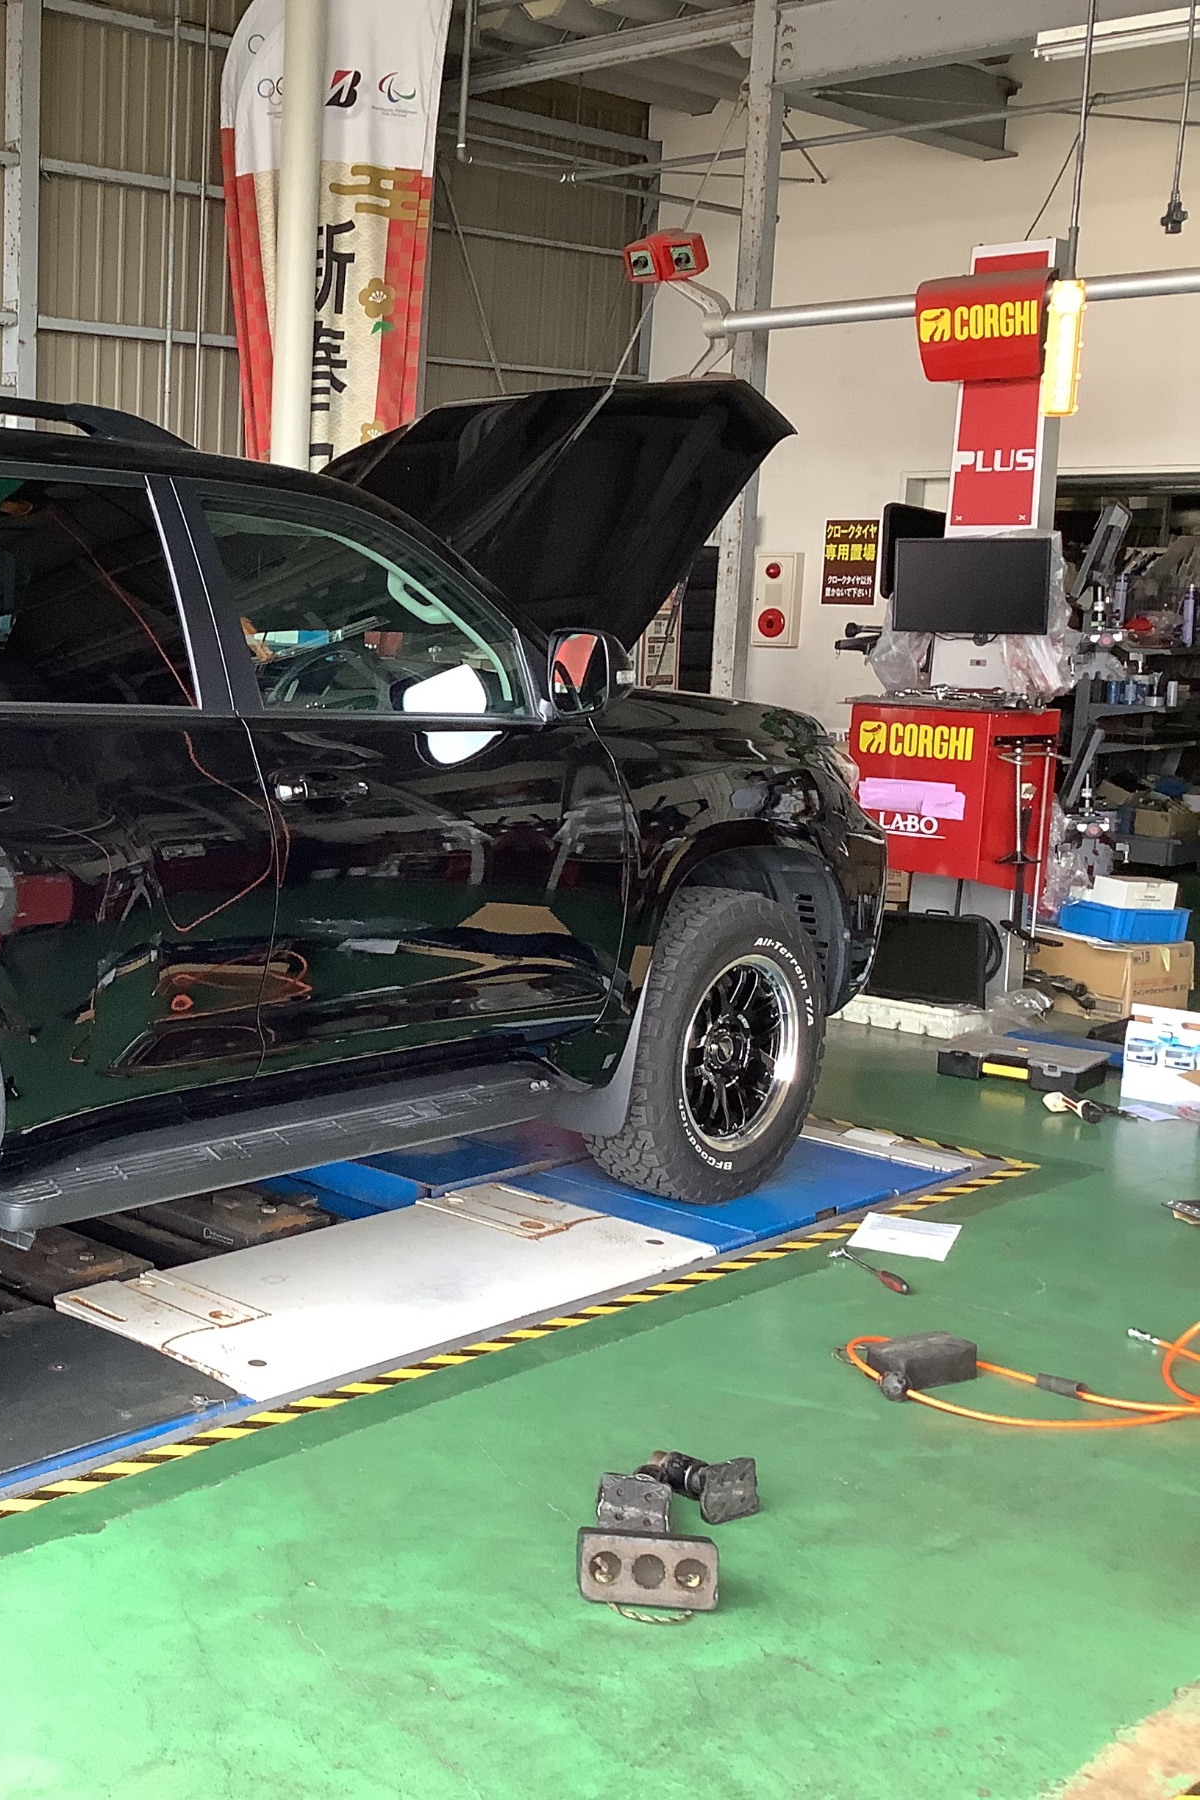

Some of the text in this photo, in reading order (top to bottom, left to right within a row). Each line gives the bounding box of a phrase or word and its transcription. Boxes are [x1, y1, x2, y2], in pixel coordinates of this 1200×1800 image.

[954, 299, 1038, 341] CORGHI
[953, 448, 1036, 473] PLUS
[826, 523, 878, 539] クロークタイヤ
[824, 543, 876, 561] 専用置場
[827, 575, 873, 586] クロークタイヤ以外
[889, 722, 975, 761] CORGHI
[878, 811, 939, 835] LABO
[753, 937, 814, 1027] All-Terrain T/A
[678, 1098, 733, 1171] BFGoodrich
